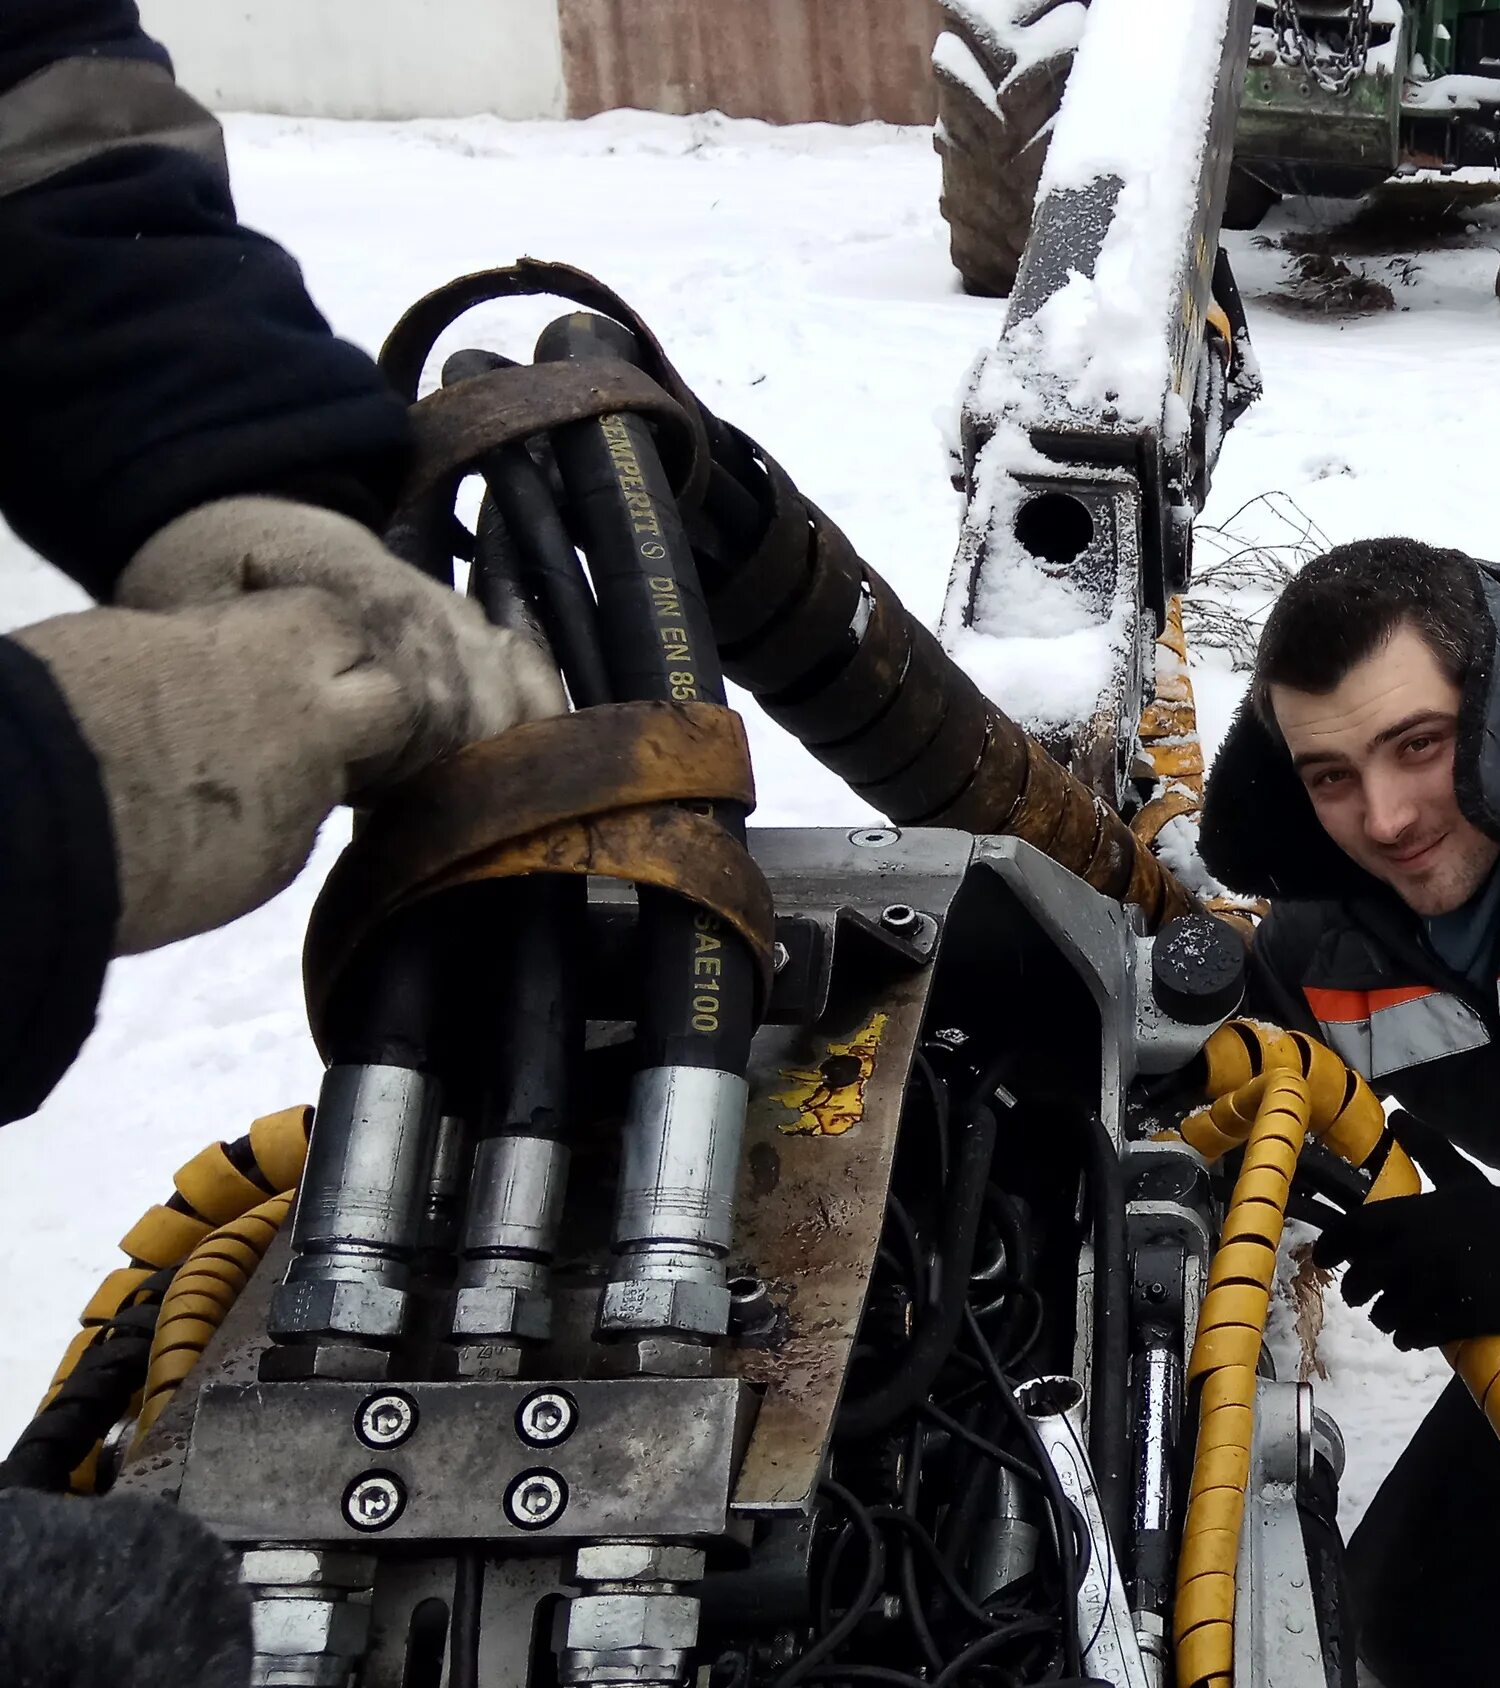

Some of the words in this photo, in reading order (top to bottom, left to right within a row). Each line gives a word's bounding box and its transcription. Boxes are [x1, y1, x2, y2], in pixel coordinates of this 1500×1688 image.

[599, 414, 661, 536] SEMPERIT
[649, 576, 681, 617] DIN
[660, 627, 691, 662] EN
[691, 912, 721, 1032] SAE100
